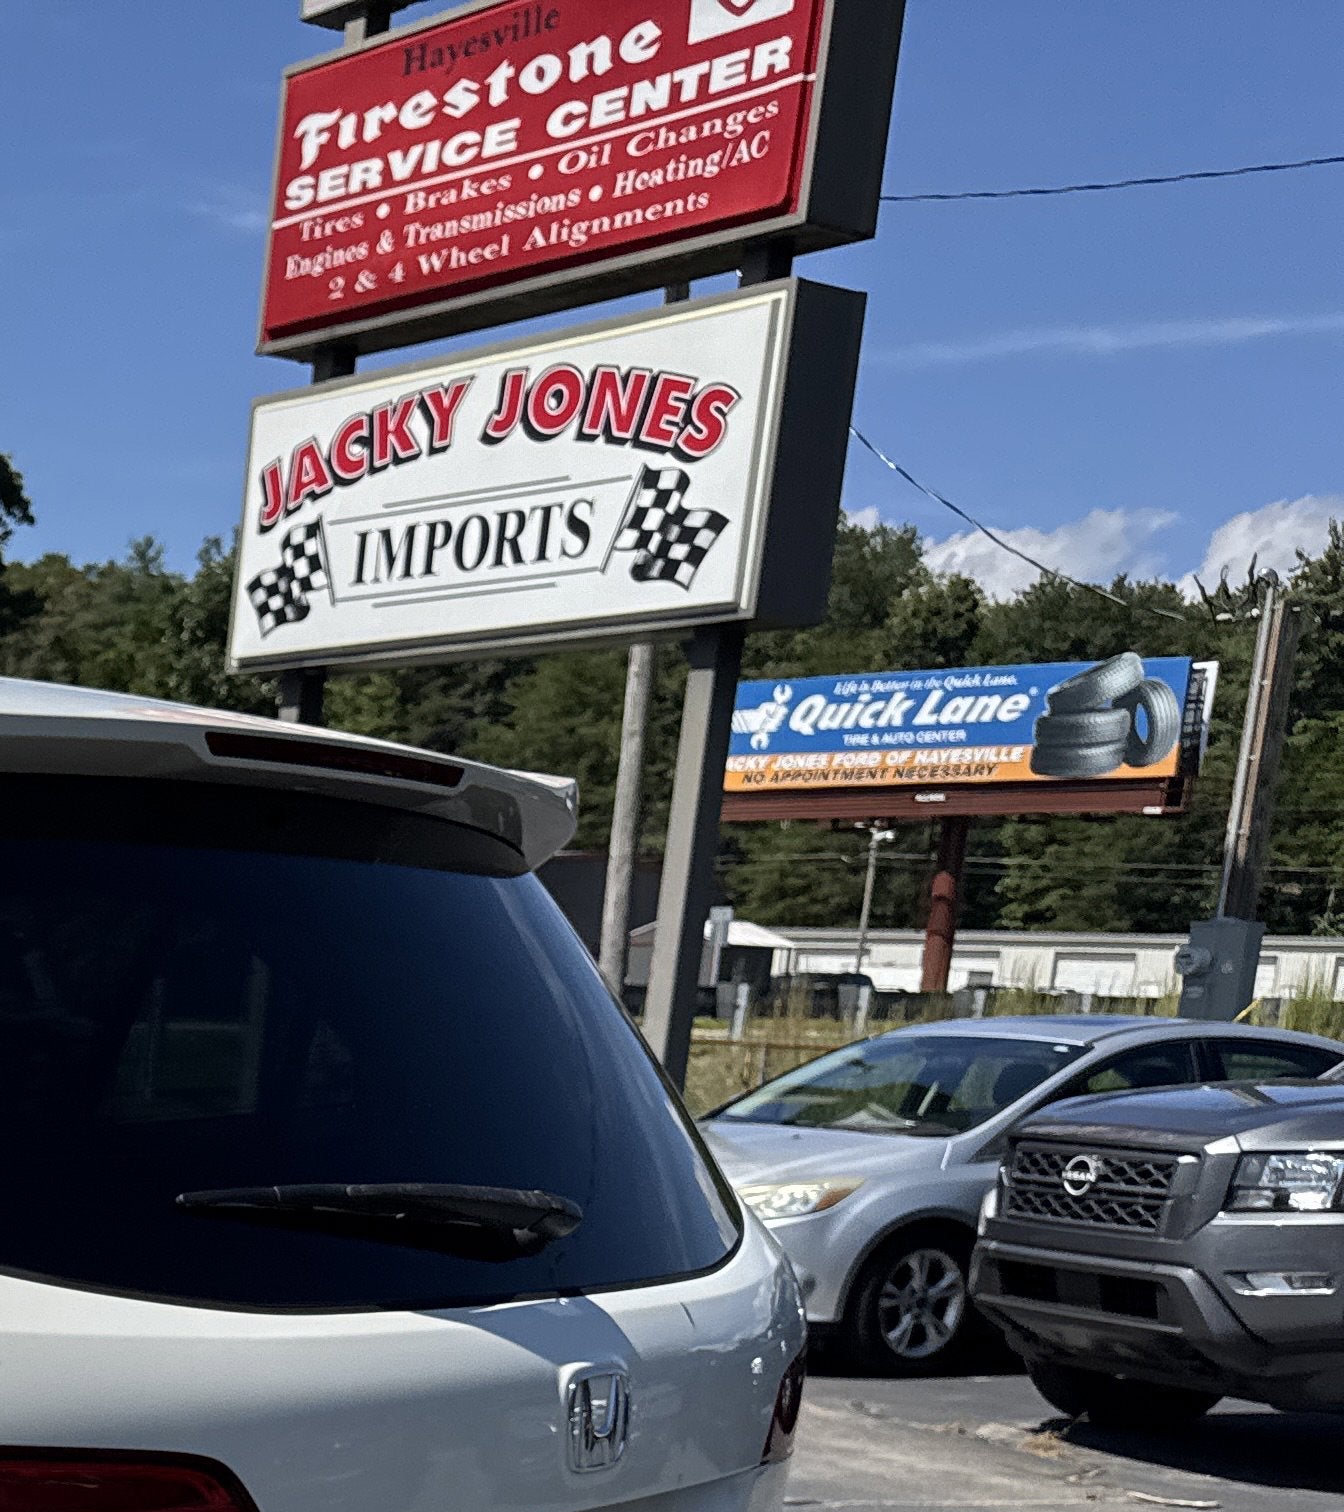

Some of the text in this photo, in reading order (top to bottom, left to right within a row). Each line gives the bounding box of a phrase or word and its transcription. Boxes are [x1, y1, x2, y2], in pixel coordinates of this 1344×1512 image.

[402, 6, 560, 76] Hayesville
[284, 35, 793, 210] SERVICE CENTER
[293, 19, 662, 171] Firestone
[284, 129, 770, 280] Engines & Transmissions Heating/AC
[299, 100, 779, 242] Tires Brakes Oil Changes
[328, 191, 710, 300] 2 & 4 Wheel Alignments
[258, 361, 743, 536] JACKY JONES
[351, 498, 596, 588] IMPORTS
[788, 691, 916, 736] Quick
[881, 730, 915, 745] AUTO
[916, 729, 966, 744] CENTER
[885, 749, 912, 766] OF
[914, 746, 1024, 764] HAYESVILLE
[741, 762, 997, 785] NO APPOINTMENT NECESSARY
